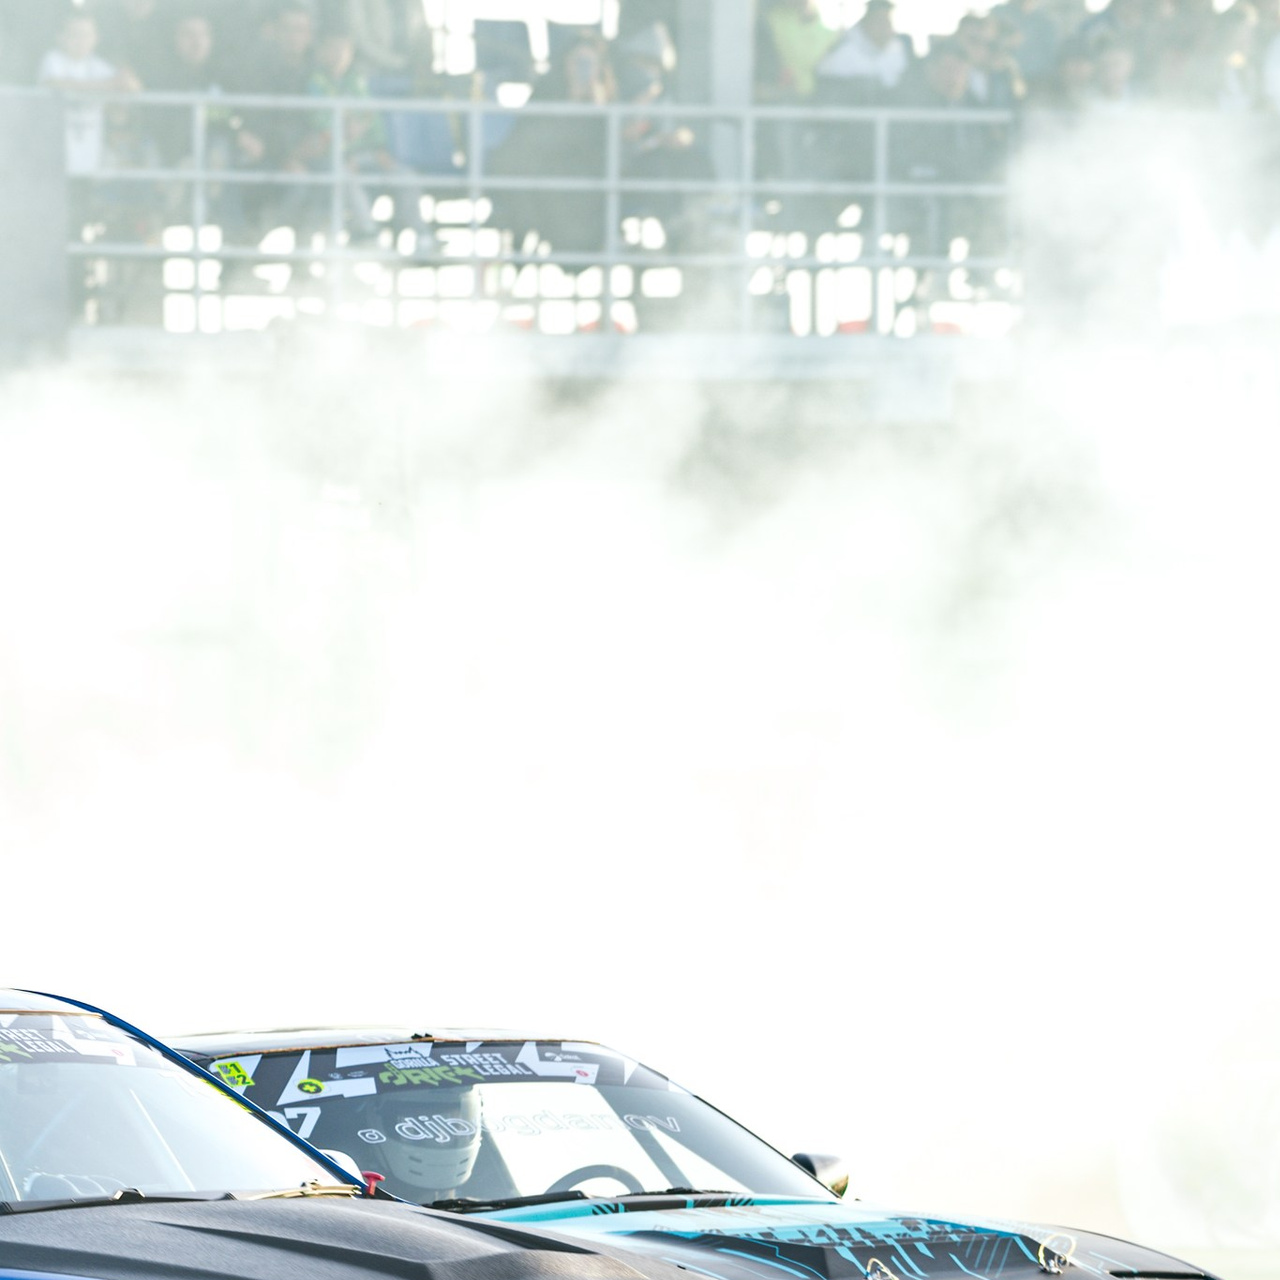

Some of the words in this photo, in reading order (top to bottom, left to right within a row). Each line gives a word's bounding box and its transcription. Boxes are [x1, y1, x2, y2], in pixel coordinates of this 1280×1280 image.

[15, 1040, 76, 1053] LEGAL
[390, 1056, 440, 1069] GORILLA
[440, 1053, 509, 1067] STREET
[473, 1064, 533, 1076] LEGAL
